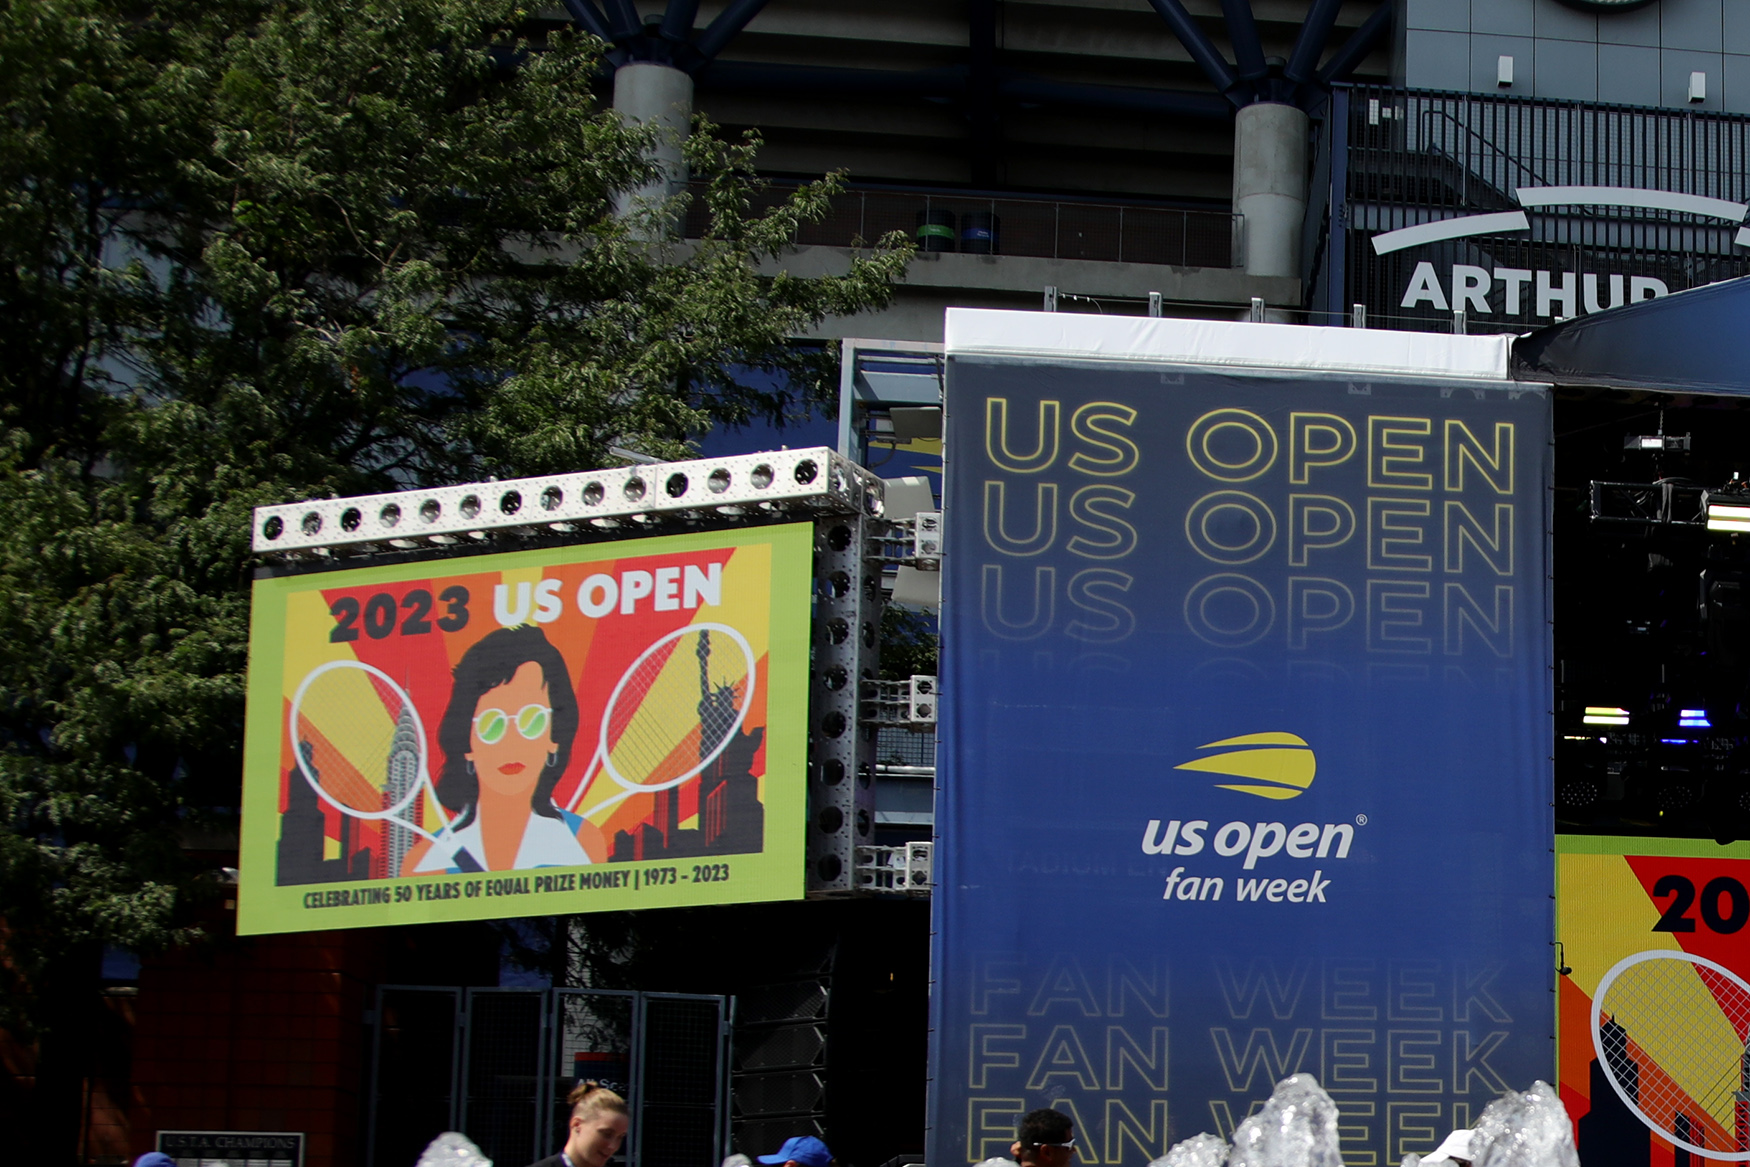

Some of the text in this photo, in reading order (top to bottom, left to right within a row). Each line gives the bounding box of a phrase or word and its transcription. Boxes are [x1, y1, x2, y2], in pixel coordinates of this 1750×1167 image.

[985, 397, 1514, 494] US OPEN
[983, 480, 1513, 576] US OPEN
[330, 563, 722, 643] 2023 US OPEN
[980, 564, 1513, 657] US OPEN
[1141, 819, 1208, 855] us
[1213, 821, 1354, 870] open
[303, 886, 390, 909] CELEBRATING
[394, 885, 412, 902] 50
[416, 881, 460, 901] YEARS
[464, 880, 482, 898] OF
[485, 877, 530, 896] EQUAL
[534, 873, 575, 893] PRIZE
[579, 870, 630, 890] MONEY
[643, 867, 676, 886] 1973
[692, 863, 729, 883] 2023
[1163, 866, 1331, 903] fan week
[970, 949, 1513, 1023] FAN WEEK
[968, 1023, 1509, 1094] FAN WEEK
[215, 1136, 296, 1149] CHAMPIONS
